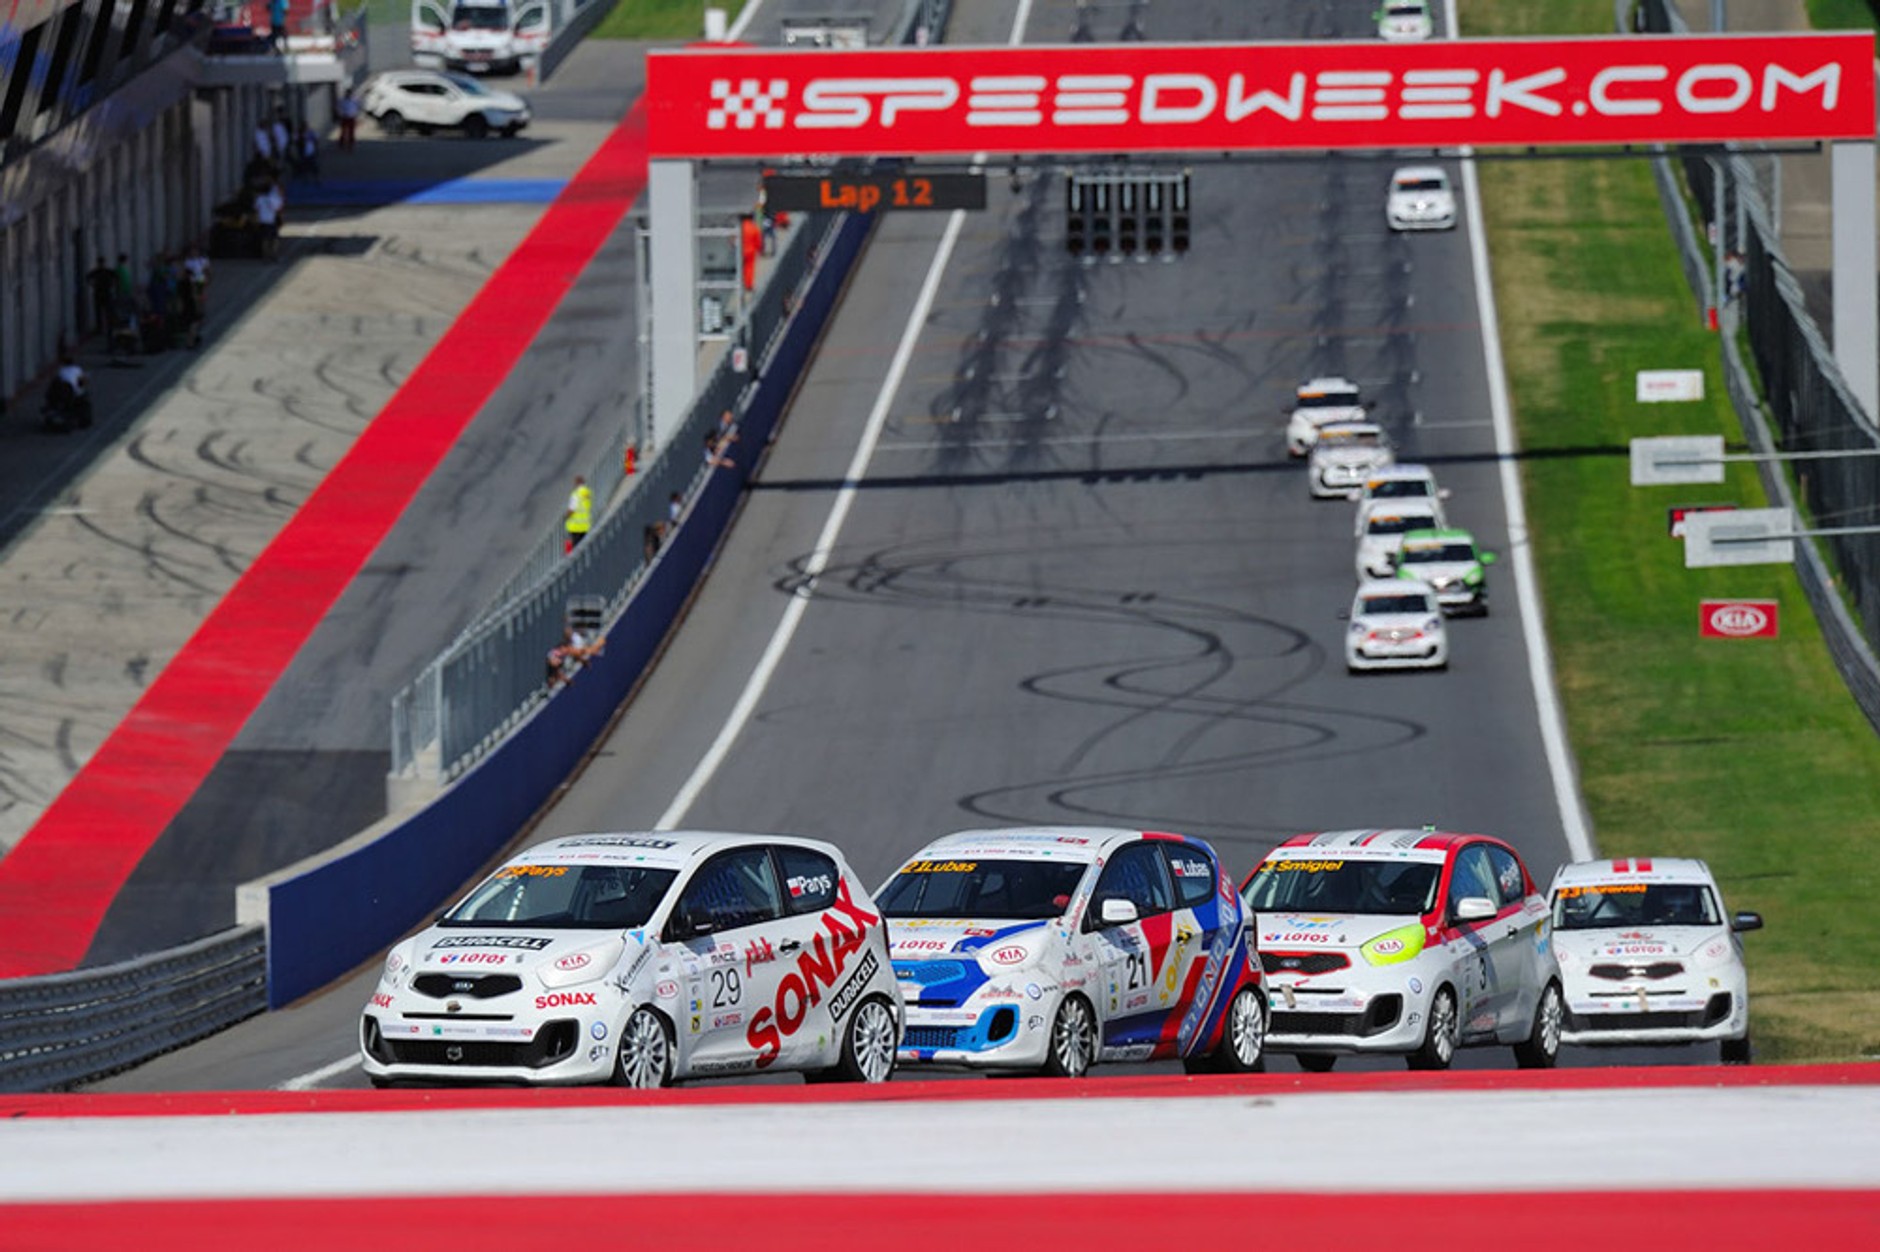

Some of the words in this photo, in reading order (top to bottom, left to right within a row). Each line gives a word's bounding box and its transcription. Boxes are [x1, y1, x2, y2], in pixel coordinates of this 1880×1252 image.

[794, 62, 1840, 129] SPEEDWEEK.COM
[820, 179, 881, 213] Lap
[892, 178, 934, 206] 12
[1719, 611, 1759, 628] KIA
[799, 874, 832, 896] Parys
[438, 938, 544, 949] DURACELL
[899, 940, 947, 950] LOTOS
[1284, 933, 1329, 943] LOTOS
[1378, 940, 1400, 951] KIA
[459, 953, 508, 964] LOTOS
[561, 954, 585, 967] KIA
[997, 949, 1023, 961] KIA
[747, 876, 878, 1069] SONAX
[1126, 951, 1147, 990] 21
[1479, 956, 1487, 990] 3
[711, 967, 742, 1009] 29
[830, 952, 879, 1019] DURACELL
[535, 992, 597, 1010] SONAX
